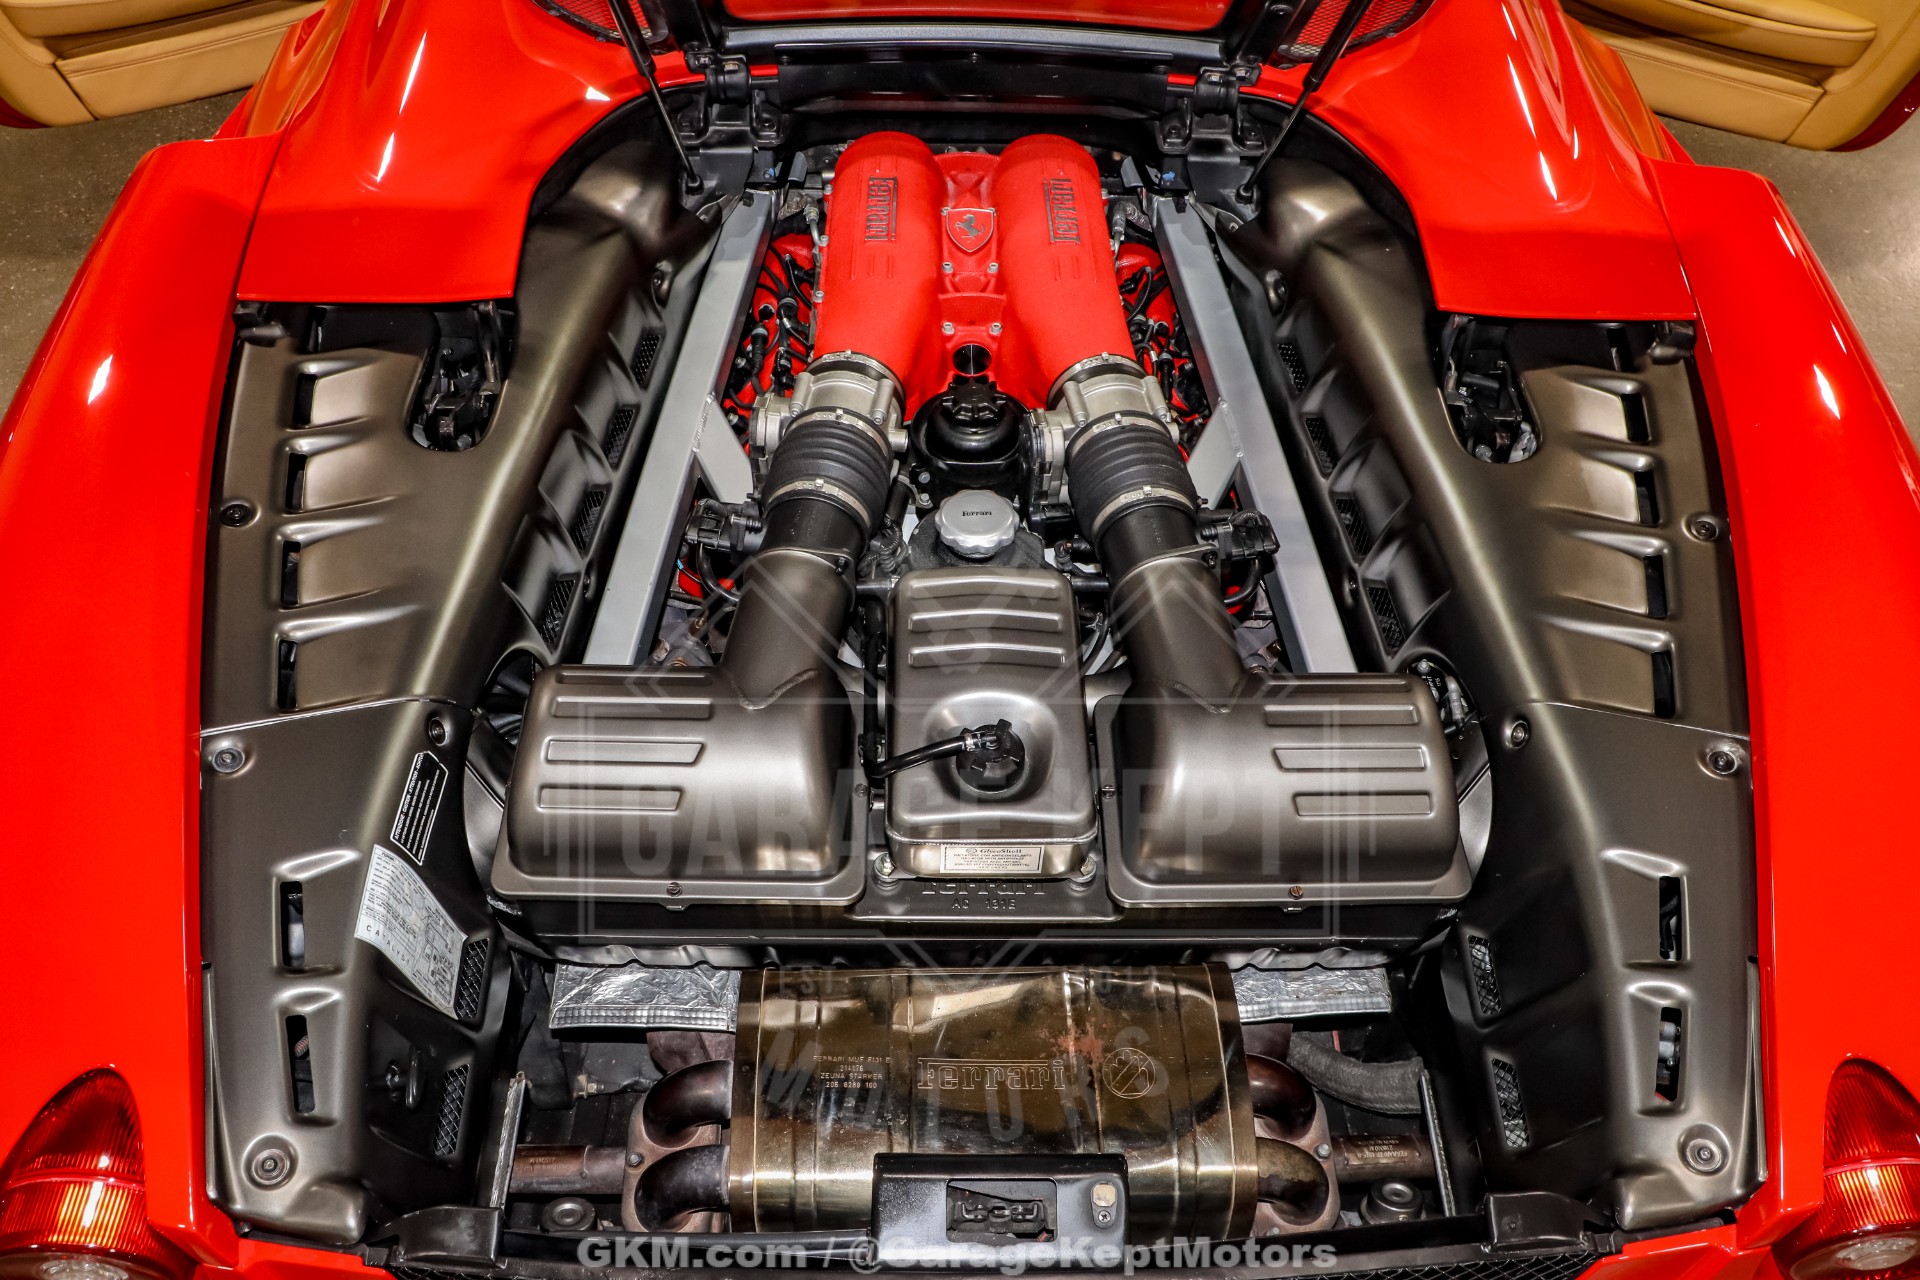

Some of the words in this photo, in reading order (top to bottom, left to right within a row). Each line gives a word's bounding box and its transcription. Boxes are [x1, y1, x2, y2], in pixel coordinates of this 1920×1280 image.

[865, 176, 898, 241] Ferrari
[1043, 178, 1080, 243] Ferrari
[866, 1081, 877, 1089] 100
[917, 1057, 1066, 1090] Ferrari
